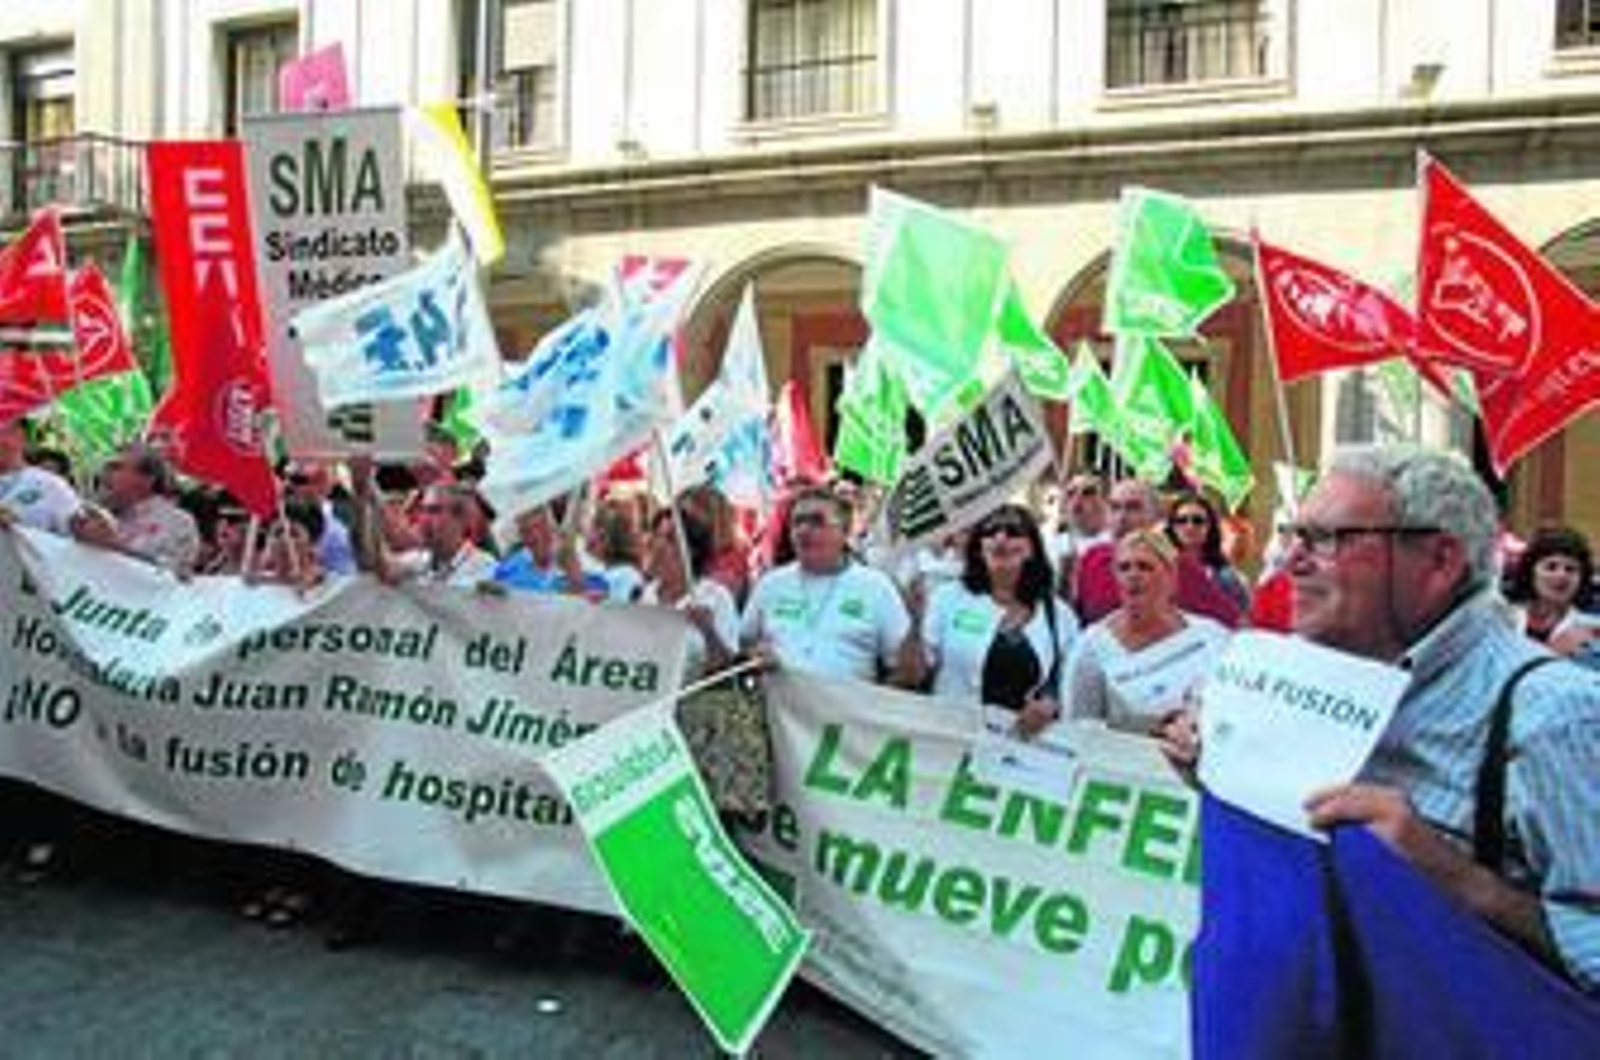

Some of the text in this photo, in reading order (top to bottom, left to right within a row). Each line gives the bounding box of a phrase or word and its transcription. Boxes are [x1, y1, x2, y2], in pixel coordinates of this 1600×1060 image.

[269, 137, 385, 217] SMA
[265, 226, 399, 262] Sindicato
[933, 394, 1014, 486] SMA
[48, 585, 169, 643] Junta
[464, 633, 527, 674] del
[551, 632, 659, 691] Área
[193, 672, 309, 710] Juan
[165, 737, 310, 780] fusión
[804, 723, 912, 809] LA
[814, 829, 1089, 954] mueve
